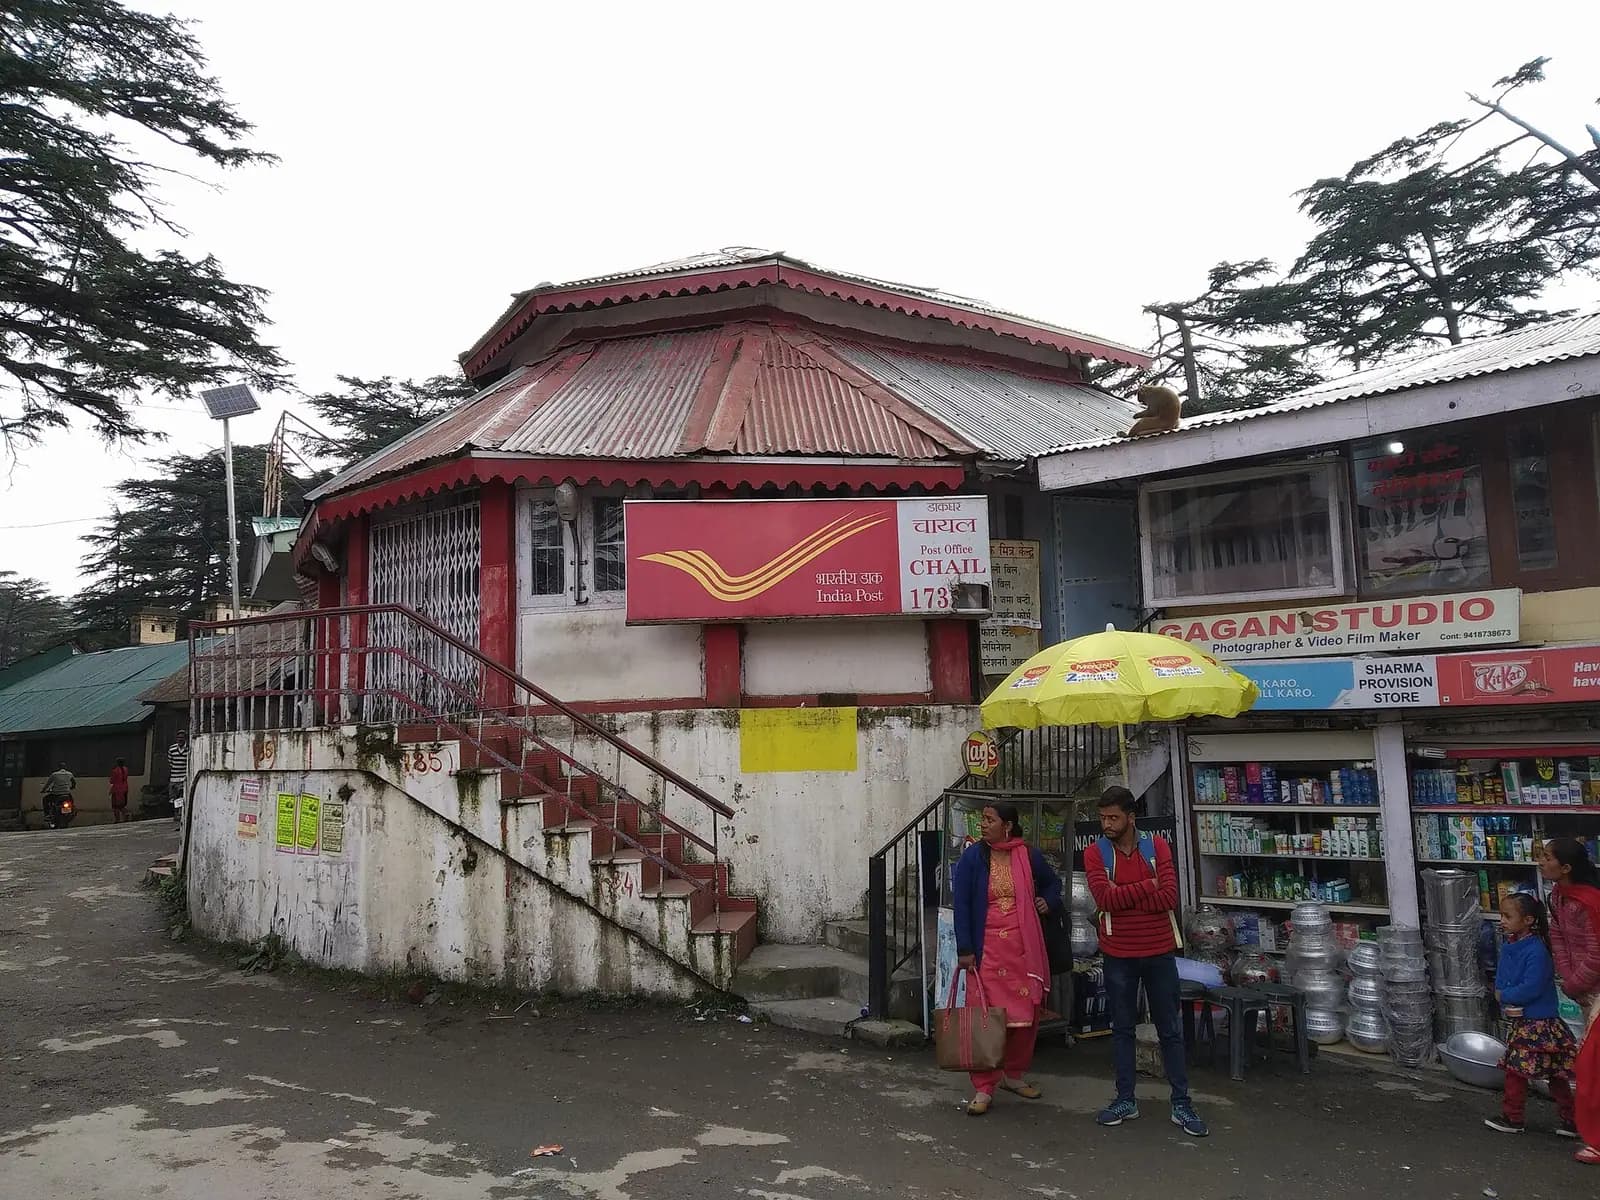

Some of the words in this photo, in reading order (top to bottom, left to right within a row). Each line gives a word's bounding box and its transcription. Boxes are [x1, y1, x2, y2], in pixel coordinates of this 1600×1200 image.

[927, 502, 961, 512] डाकघर
[912, 518, 977, 534] चायल
[920, 545, 941, 555] Post
[944, 544, 973, 554] Office
[909, 558, 986, 576] CHAIL
[816, 568, 857, 585] भारतीय
[860, 572, 883, 585] डाक
[816, 589, 853, 603] India
[856, 588, 885, 602] Post
[1158, 613, 1297, 642] GAGAN
[1312, 597, 1495, 632] STUDIO
[1212, 639, 1292, 654] Photographer
[1294, 637, 1304, 648] &
[1308, 635, 1343, 647] Video
[1346, 633, 1375, 645] Film
[1379, 630, 1421, 642] Maker
[1365, 662, 1424, 675] SHARMA
[1574, 661, 1600, 673] Hav
[1262, 679, 1300, 689] KARO.
[1359, 677, 1433, 690] PROVISION
[1483, 666, 1522, 690] KitKat
[1276, 688, 1316, 698] KARO.
[1373, 691, 1420, 704] STORE
